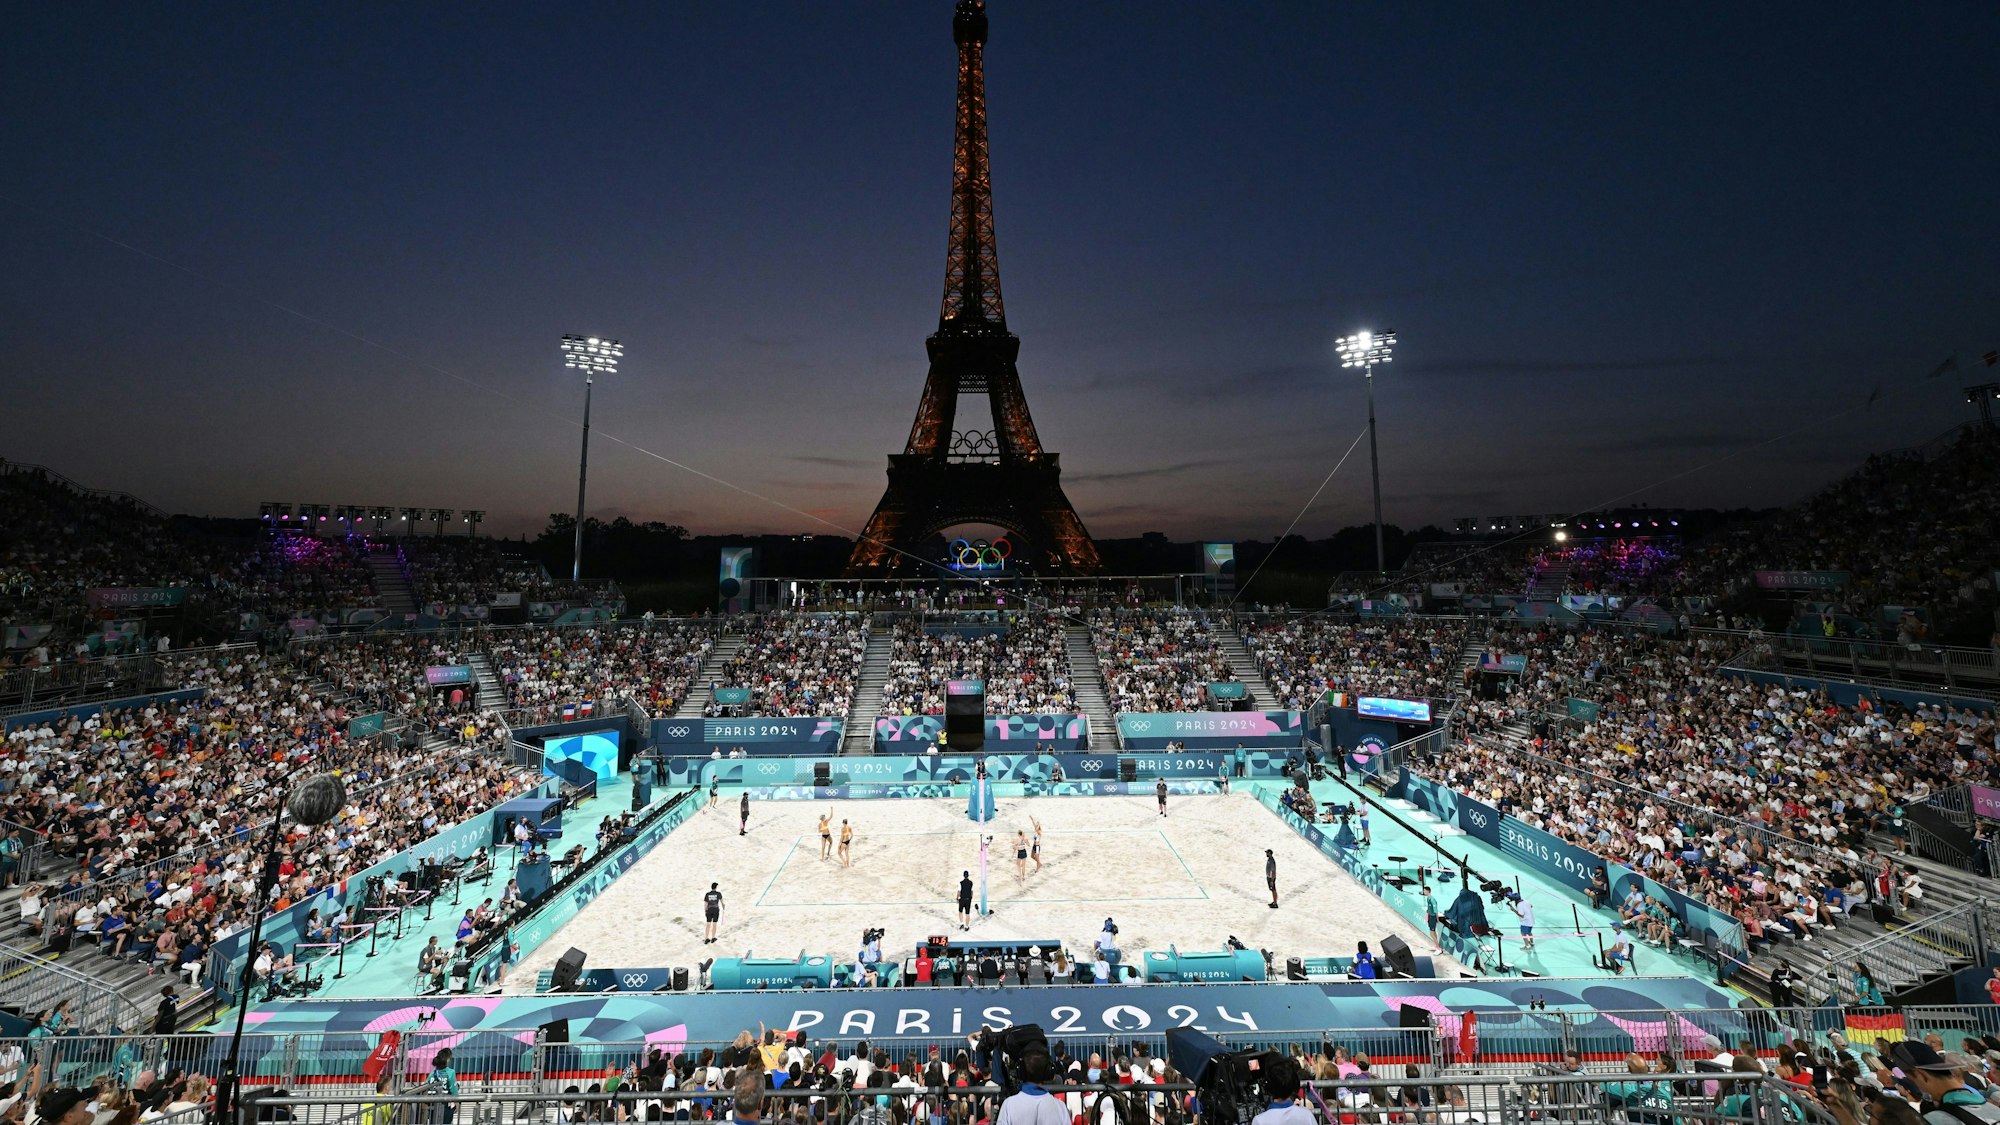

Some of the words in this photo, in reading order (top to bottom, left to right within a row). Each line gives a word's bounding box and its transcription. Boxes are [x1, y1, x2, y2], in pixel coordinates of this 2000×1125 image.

[1220, 719, 1256, 729] 2024
[760, 725, 797, 736] 2024
[854, 763, 892, 774] 2024
[1176, 759, 1214, 770] 2024
[1050, 1004, 1259, 1032] 2024
